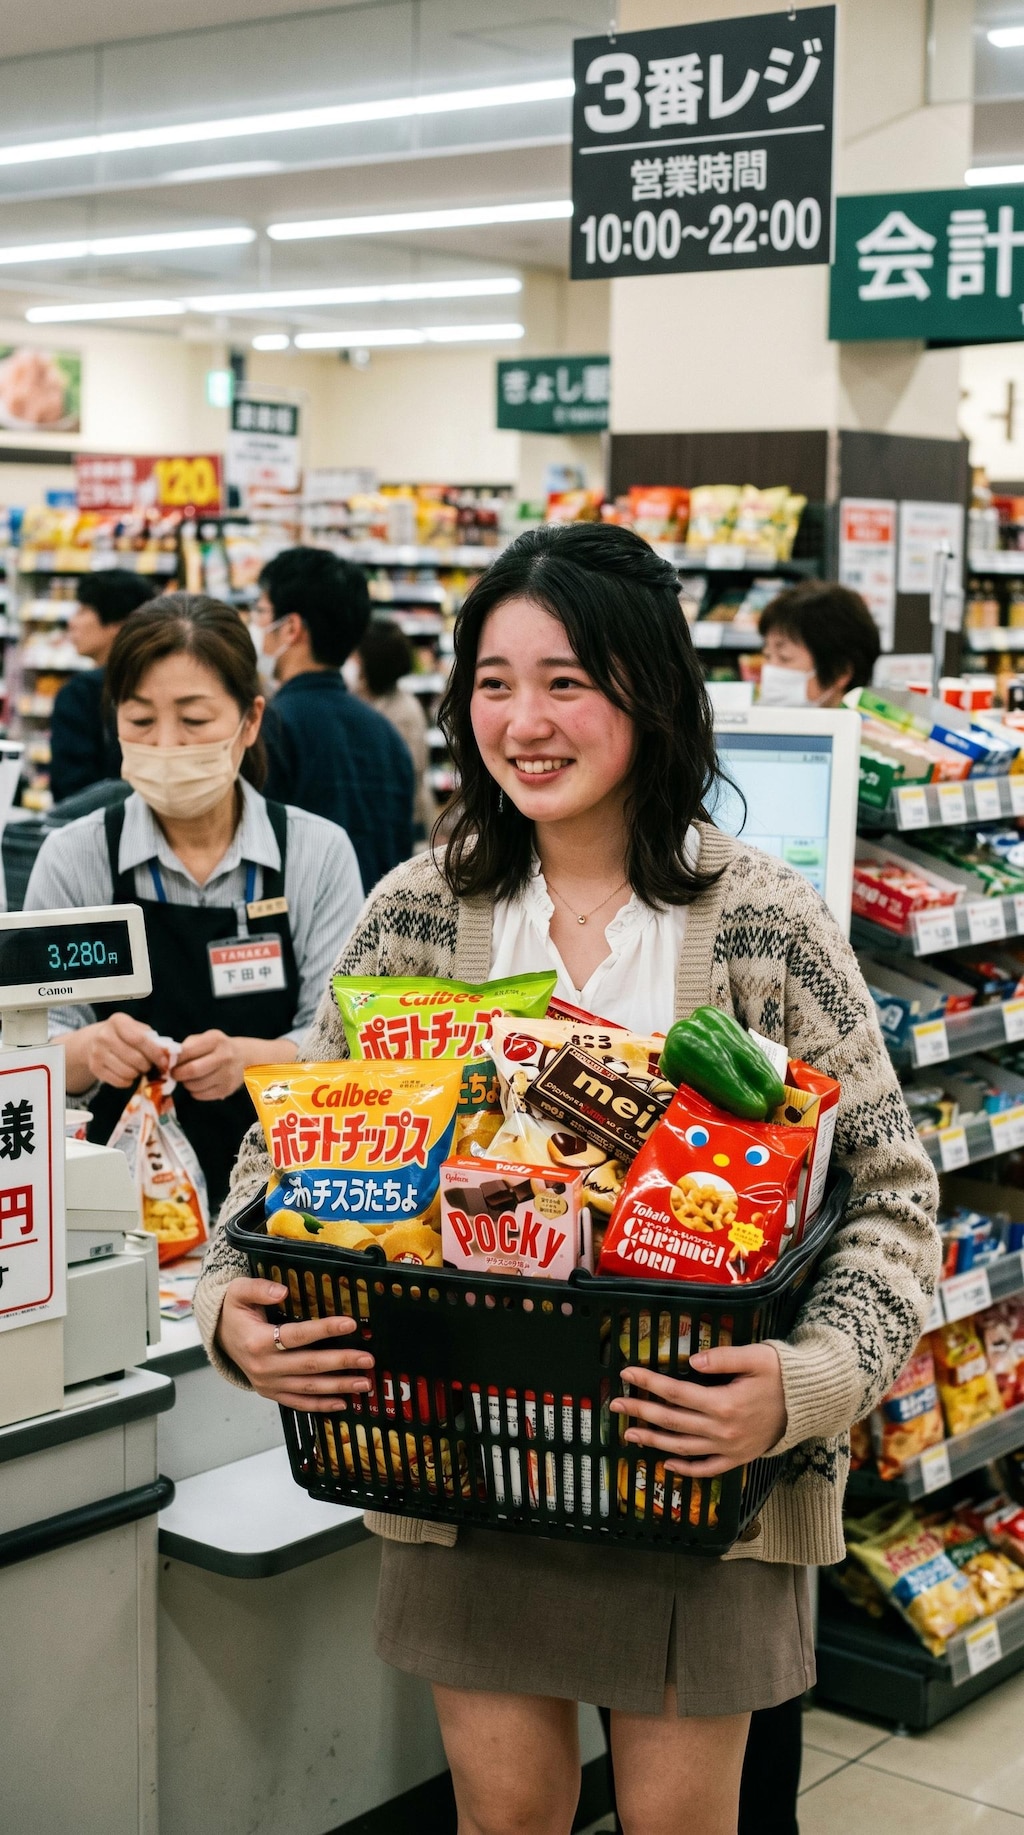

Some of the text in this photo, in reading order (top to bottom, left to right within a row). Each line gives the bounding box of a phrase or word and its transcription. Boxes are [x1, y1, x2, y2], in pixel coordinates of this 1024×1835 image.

[583, 37, 823, 133] 3番レジ
[630, 149, 768, 201] 営業時間
[855, 205, 1024, 302] 会計
[220, 947, 271, 962] TANAKA
[38, 986, 73, 997] Canon
[399, 990, 484, 1007] Calbee
[311, 1083, 393, 1108] Calbee
[271, 1109, 431, 1168] ポテトチップス
[0, 1184, 33, 1241] 円
